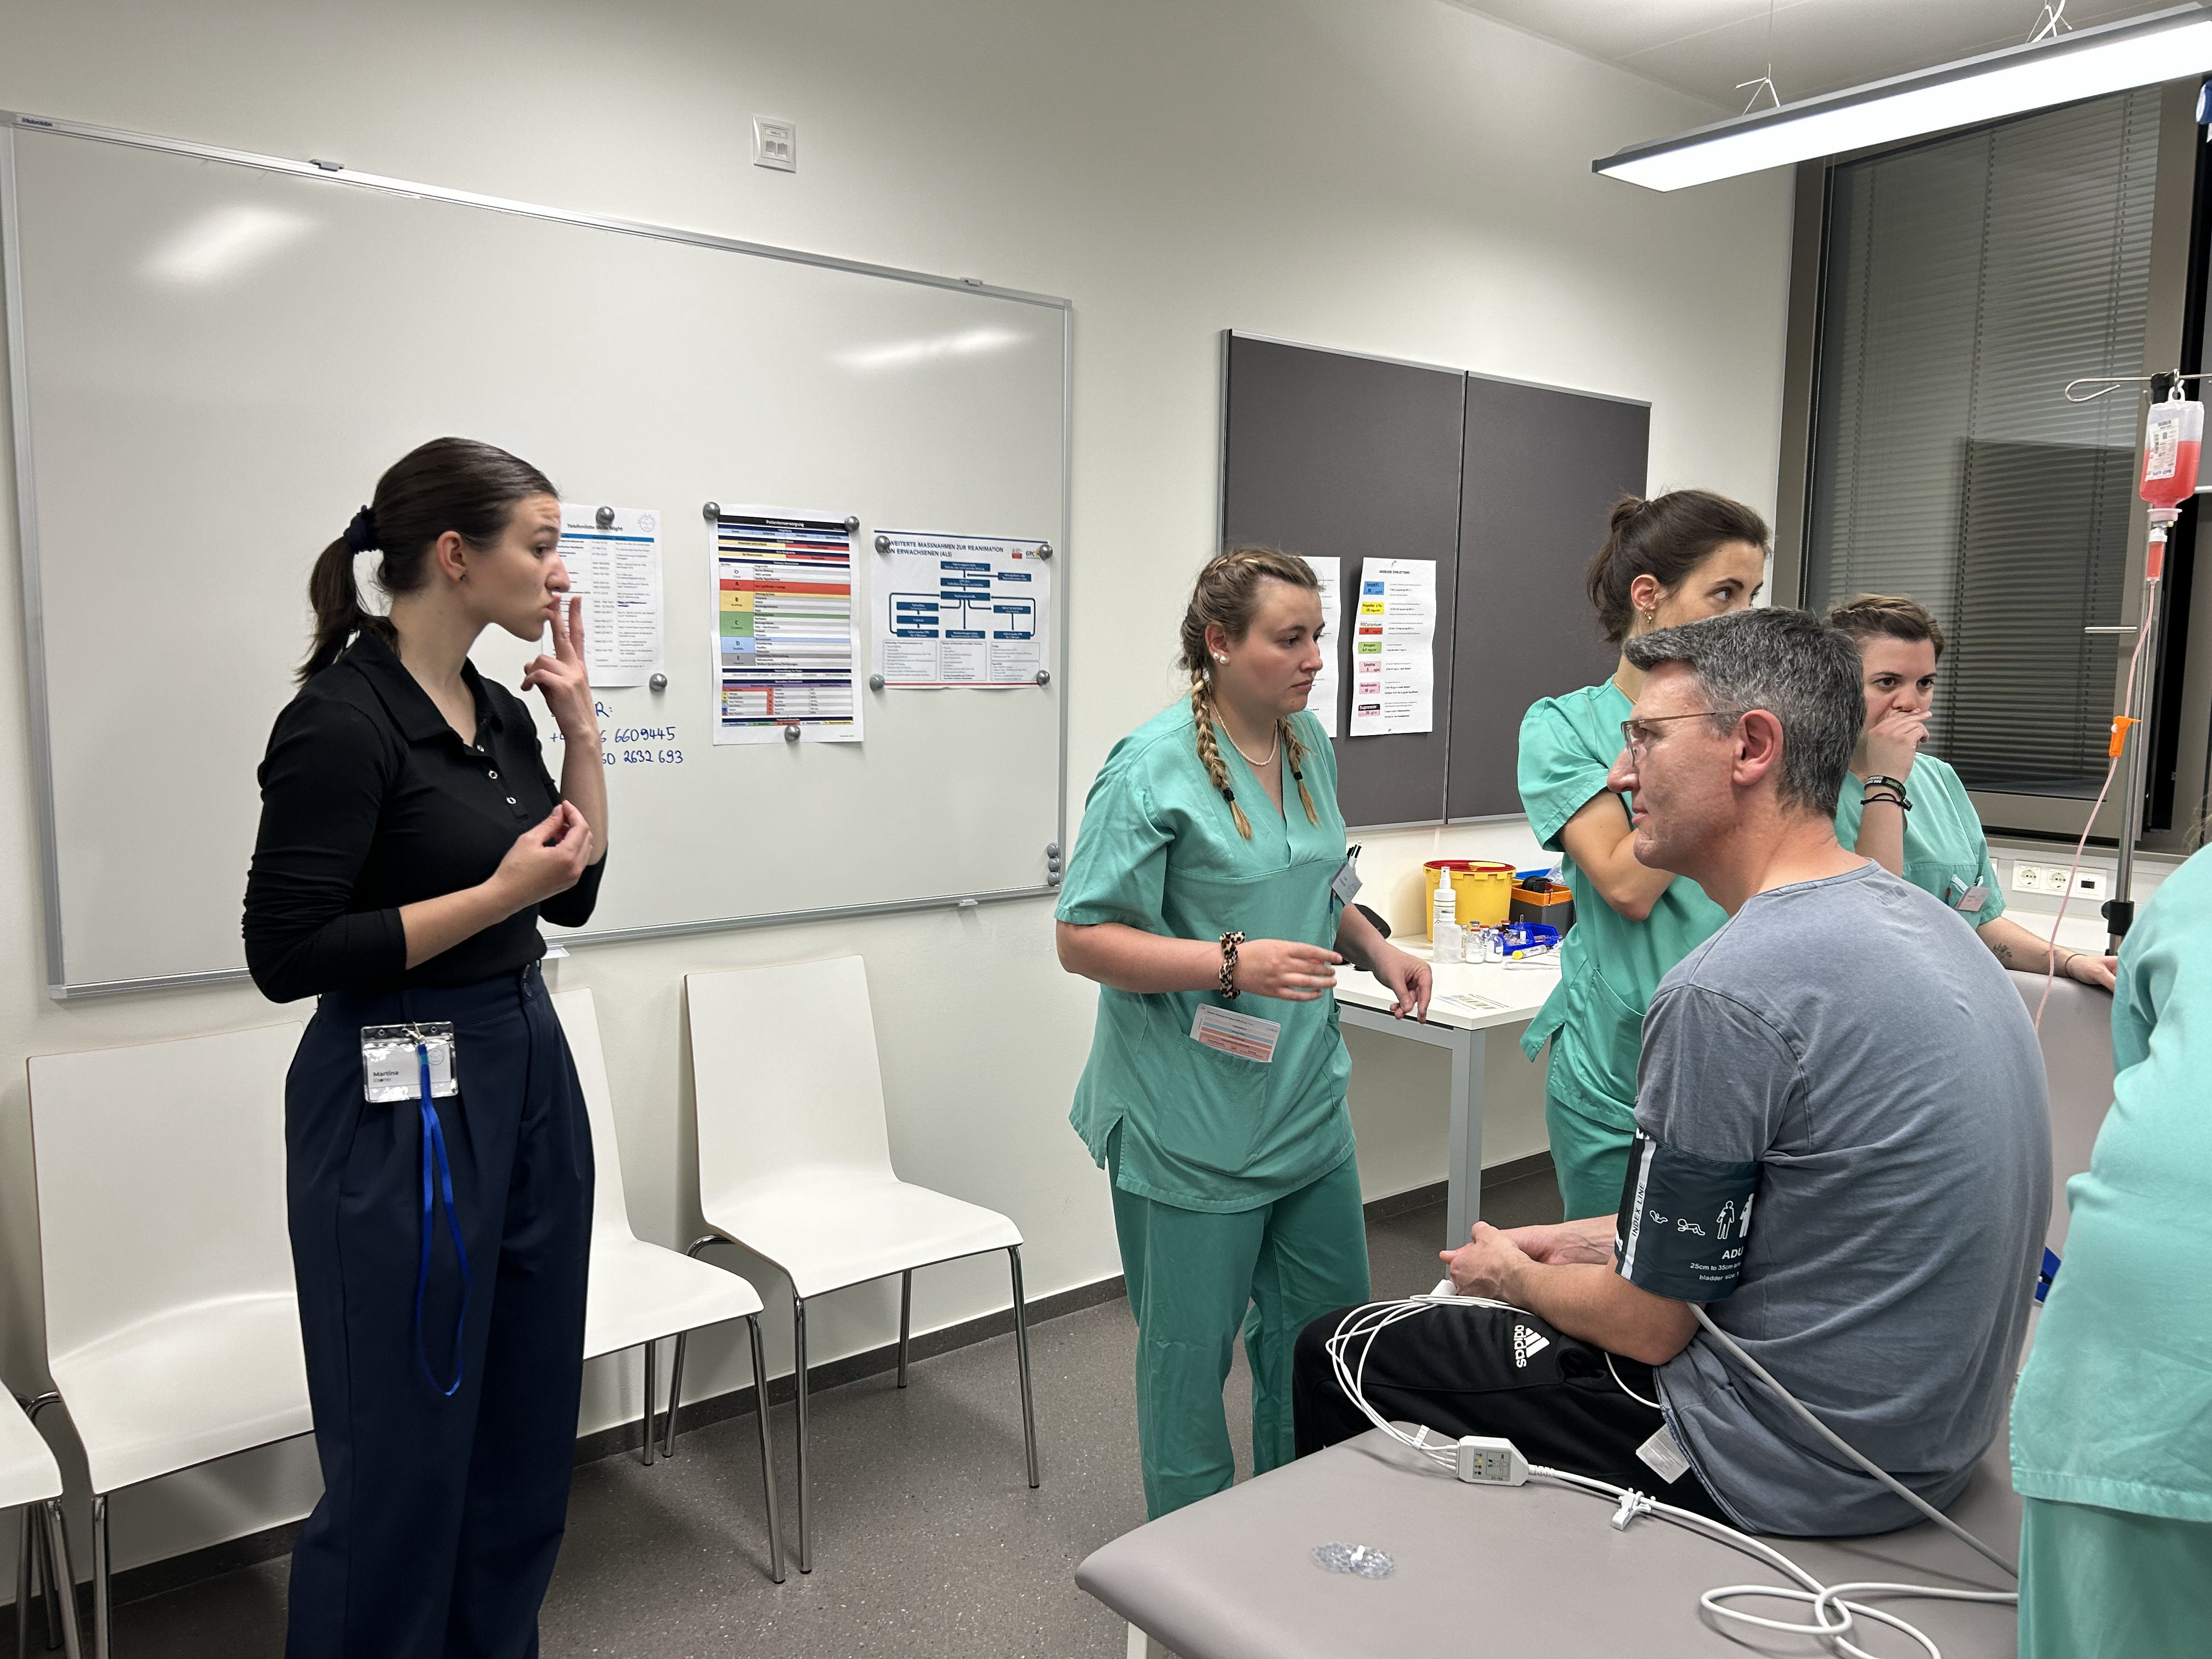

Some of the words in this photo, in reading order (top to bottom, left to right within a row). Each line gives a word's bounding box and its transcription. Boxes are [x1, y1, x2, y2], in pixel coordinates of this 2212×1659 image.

[897, 549, 939, 557] ERWACHSENEN
[918, 541, 956, 550] MASSNAHMEN
[595, 702, 612, 718] R:
[615, 727, 676, 743] 6609445
[624, 750, 654, 763] 2632
[659, 750, 683, 763] 693
[1632, 1207, 1641, 1237] INDEX
[1637, 1182, 1645, 1204] LINE
[1722, 1246, 1743, 1260] ADU
[1514, 1324, 1527, 1368] adidas
